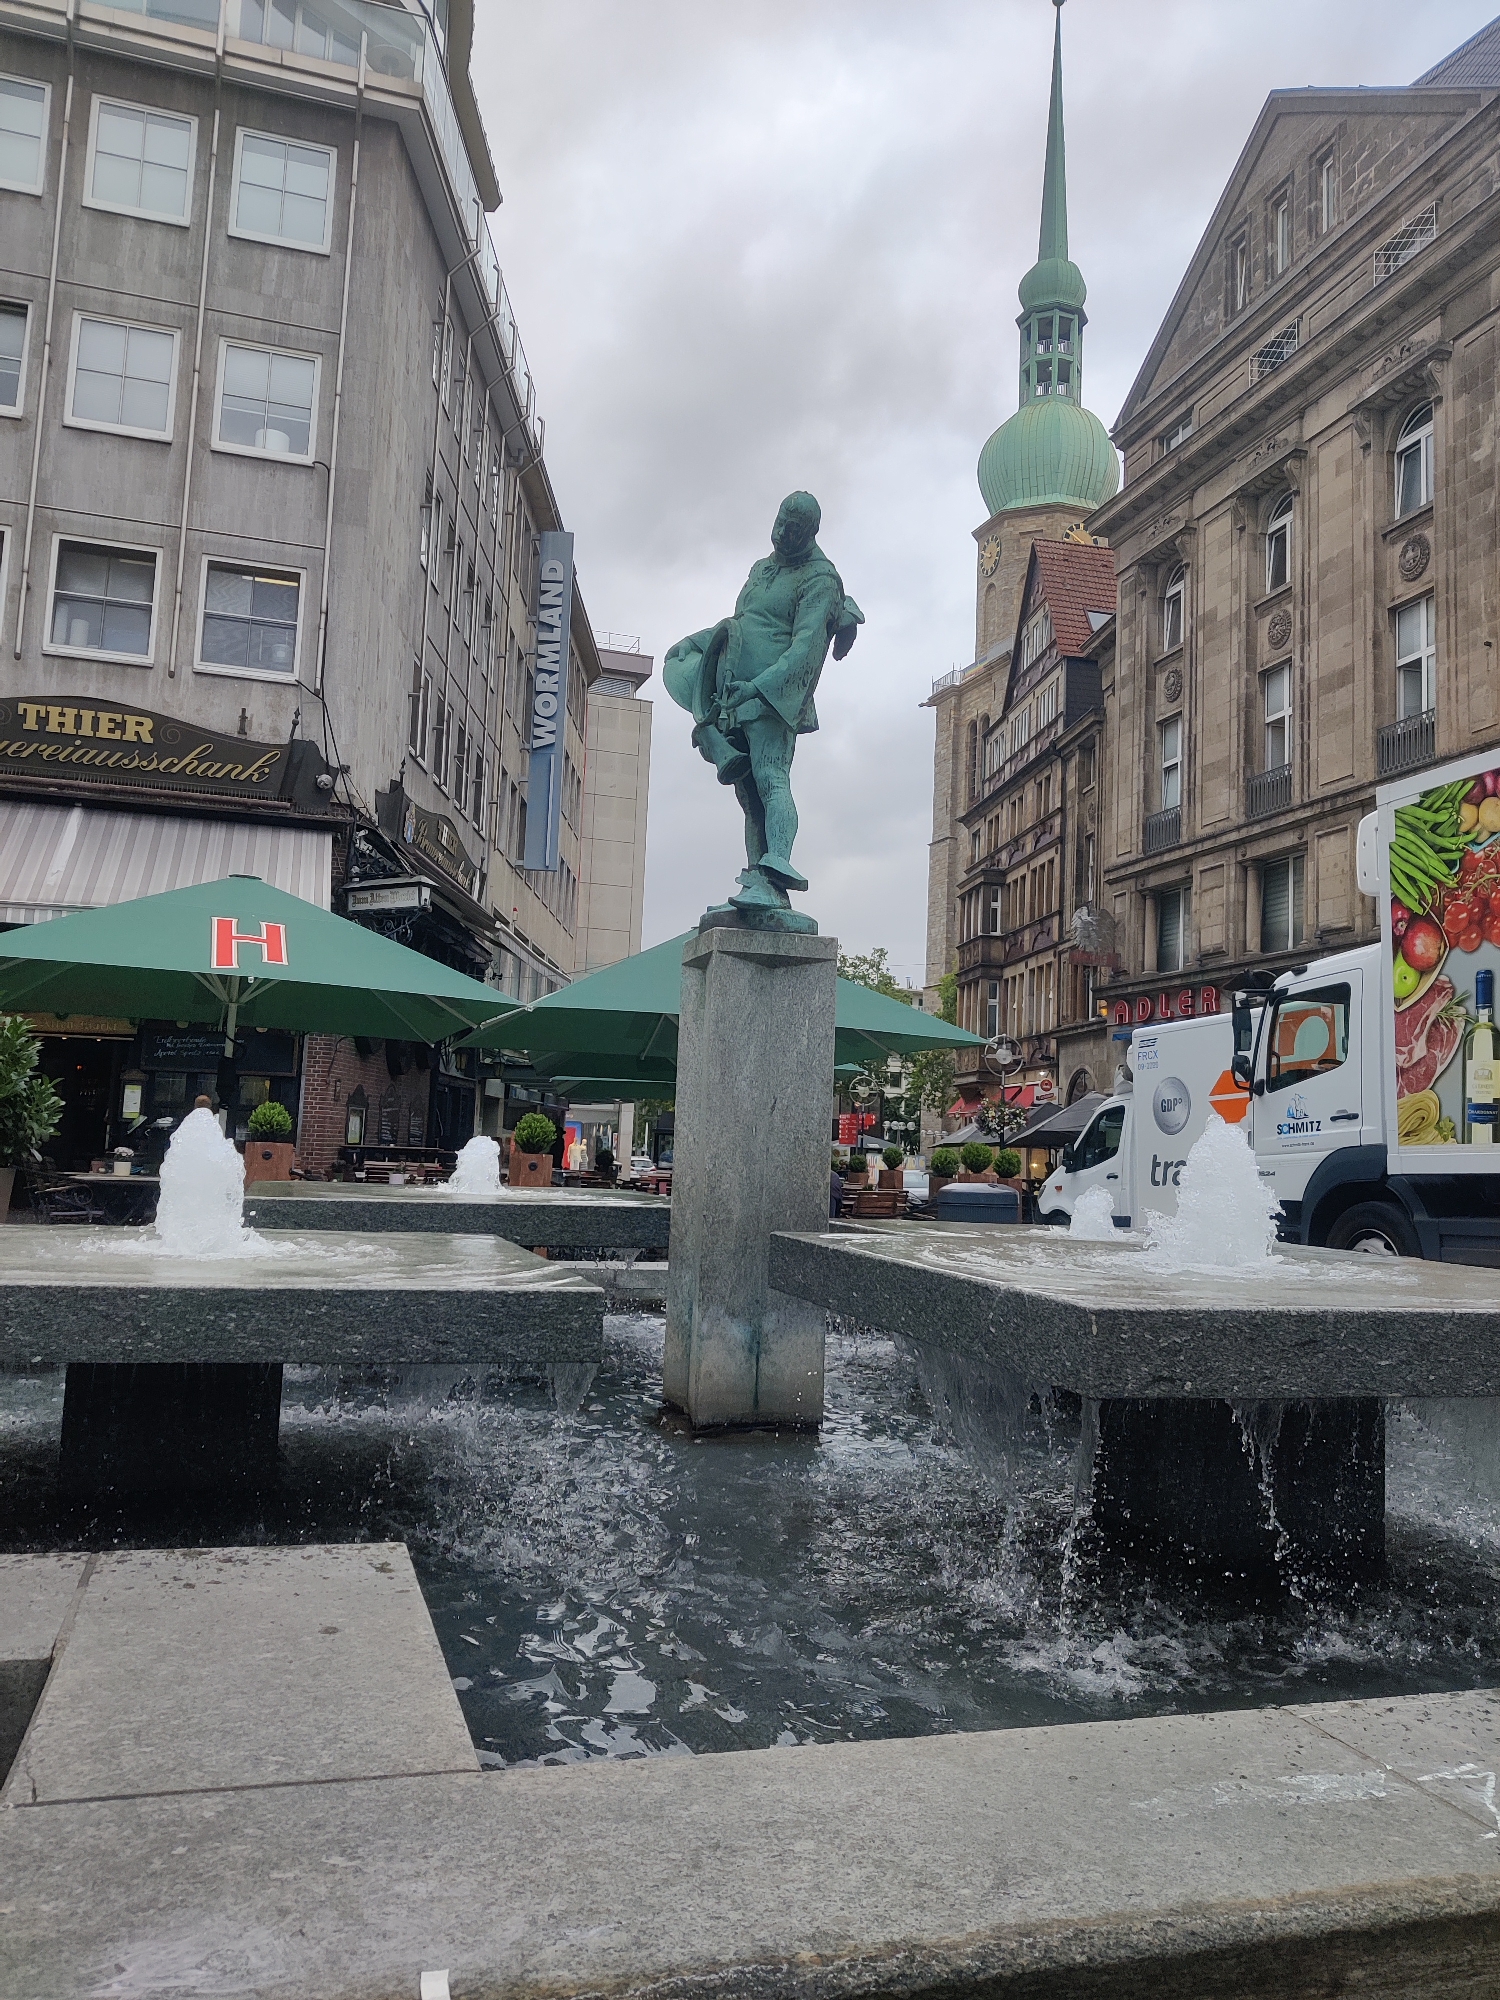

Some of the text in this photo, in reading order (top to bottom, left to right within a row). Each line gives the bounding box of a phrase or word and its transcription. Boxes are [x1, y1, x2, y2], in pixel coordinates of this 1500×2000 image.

[532, 559, 565, 749] WORMLAND
[17, 702, 154, 744] THIER
[437, 819, 459, 858] THIER
[210, 916, 289, 969] H
[1114, 985, 1220, 1025] ADLER
[1137, 1050, 1159, 1061] FRCX
[1276, 1121, 1322, 1135] SCHMITZ
